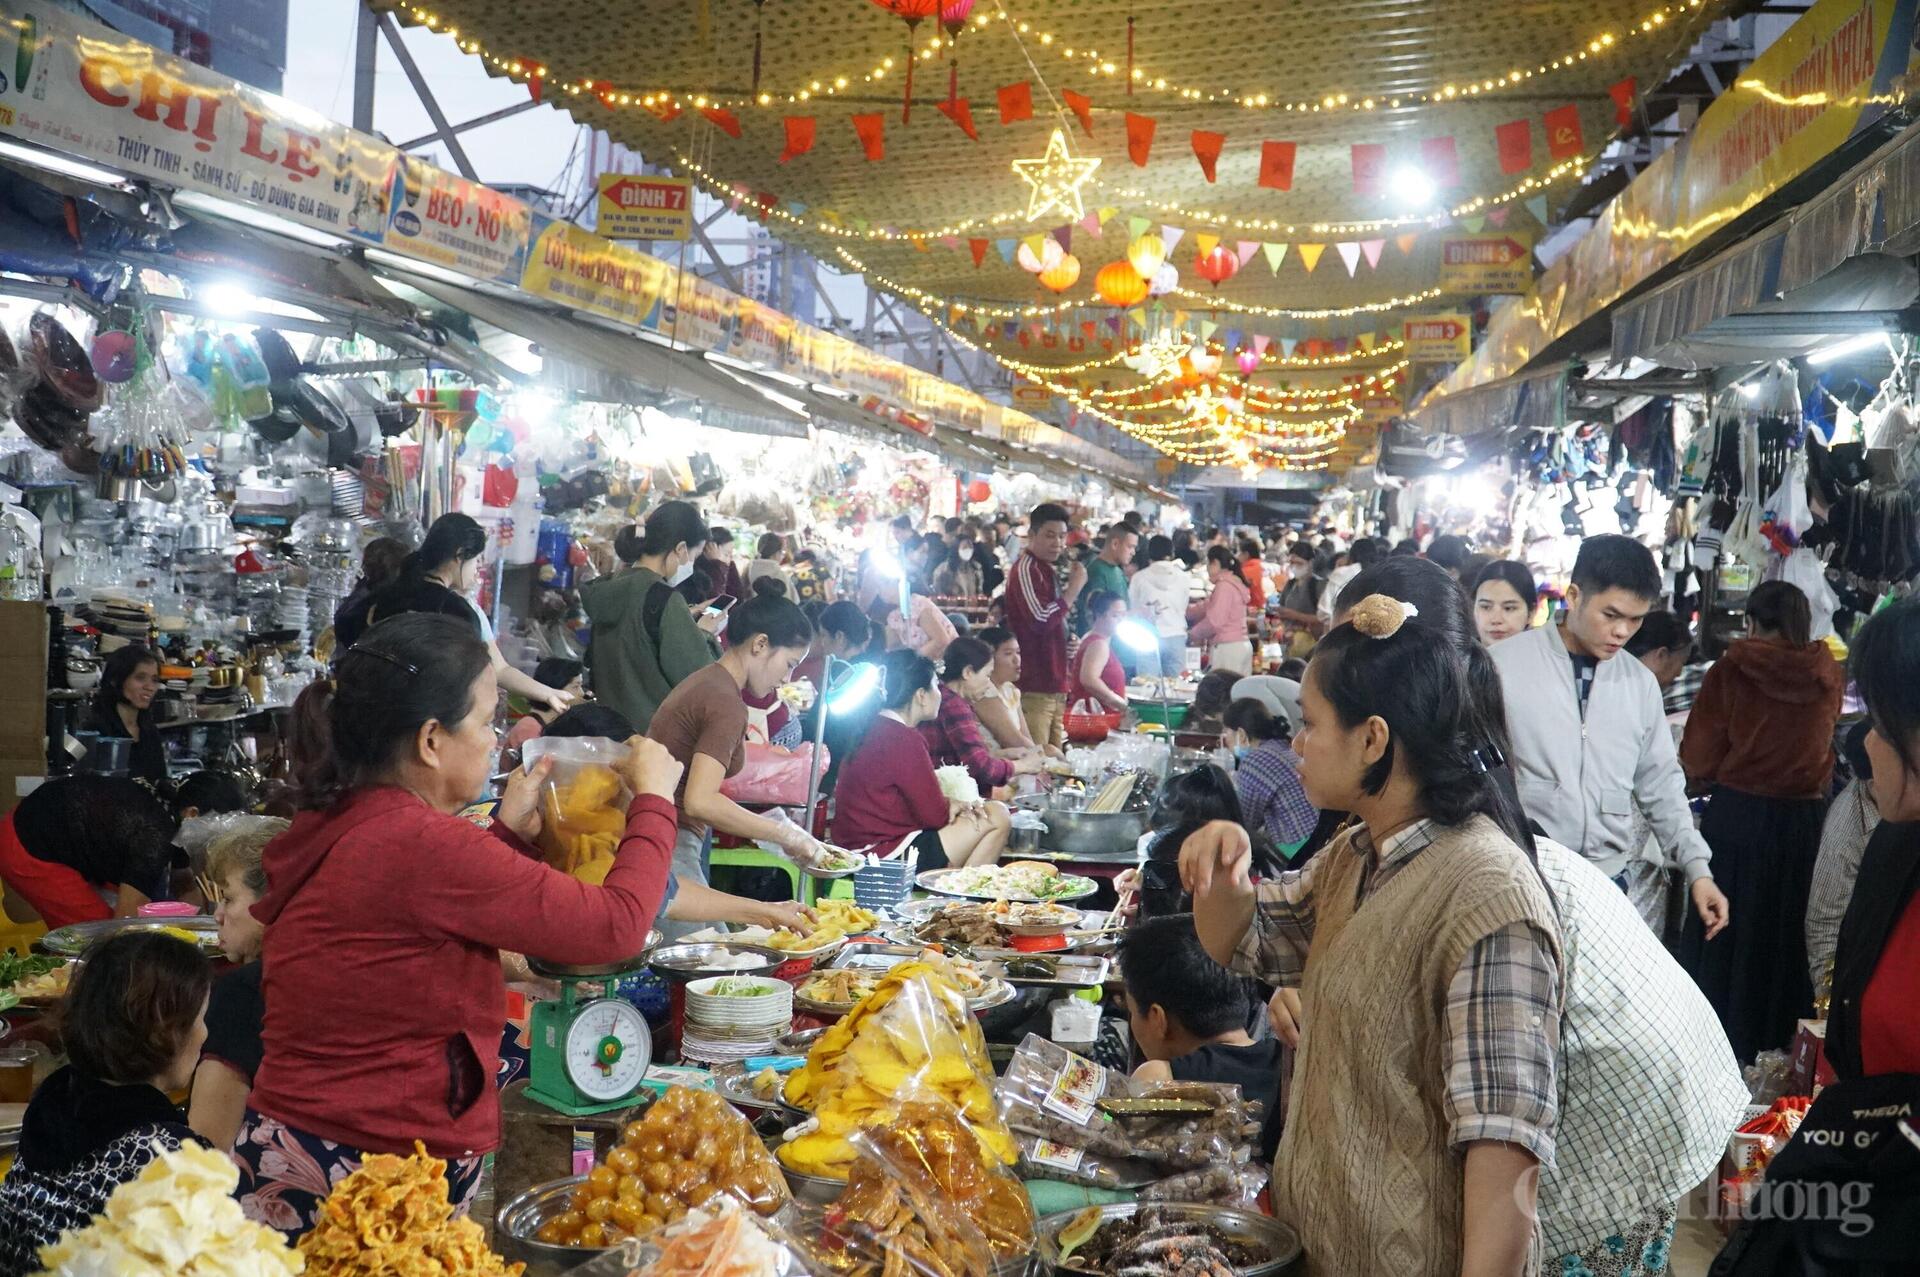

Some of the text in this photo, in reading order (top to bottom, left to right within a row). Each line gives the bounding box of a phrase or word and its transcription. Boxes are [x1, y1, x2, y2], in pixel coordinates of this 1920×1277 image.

[79, 56, 222, 153] CHỊ
[153, 147, 182, 174] TINH
[298, 195, 315, 217] GIA
[671, 190, 684, 209] 7
[1499, 244, 1511, 263] 3
[1446, 323, 1456, 340] 3
[1802, 1129, 1845, 1147] YOU
